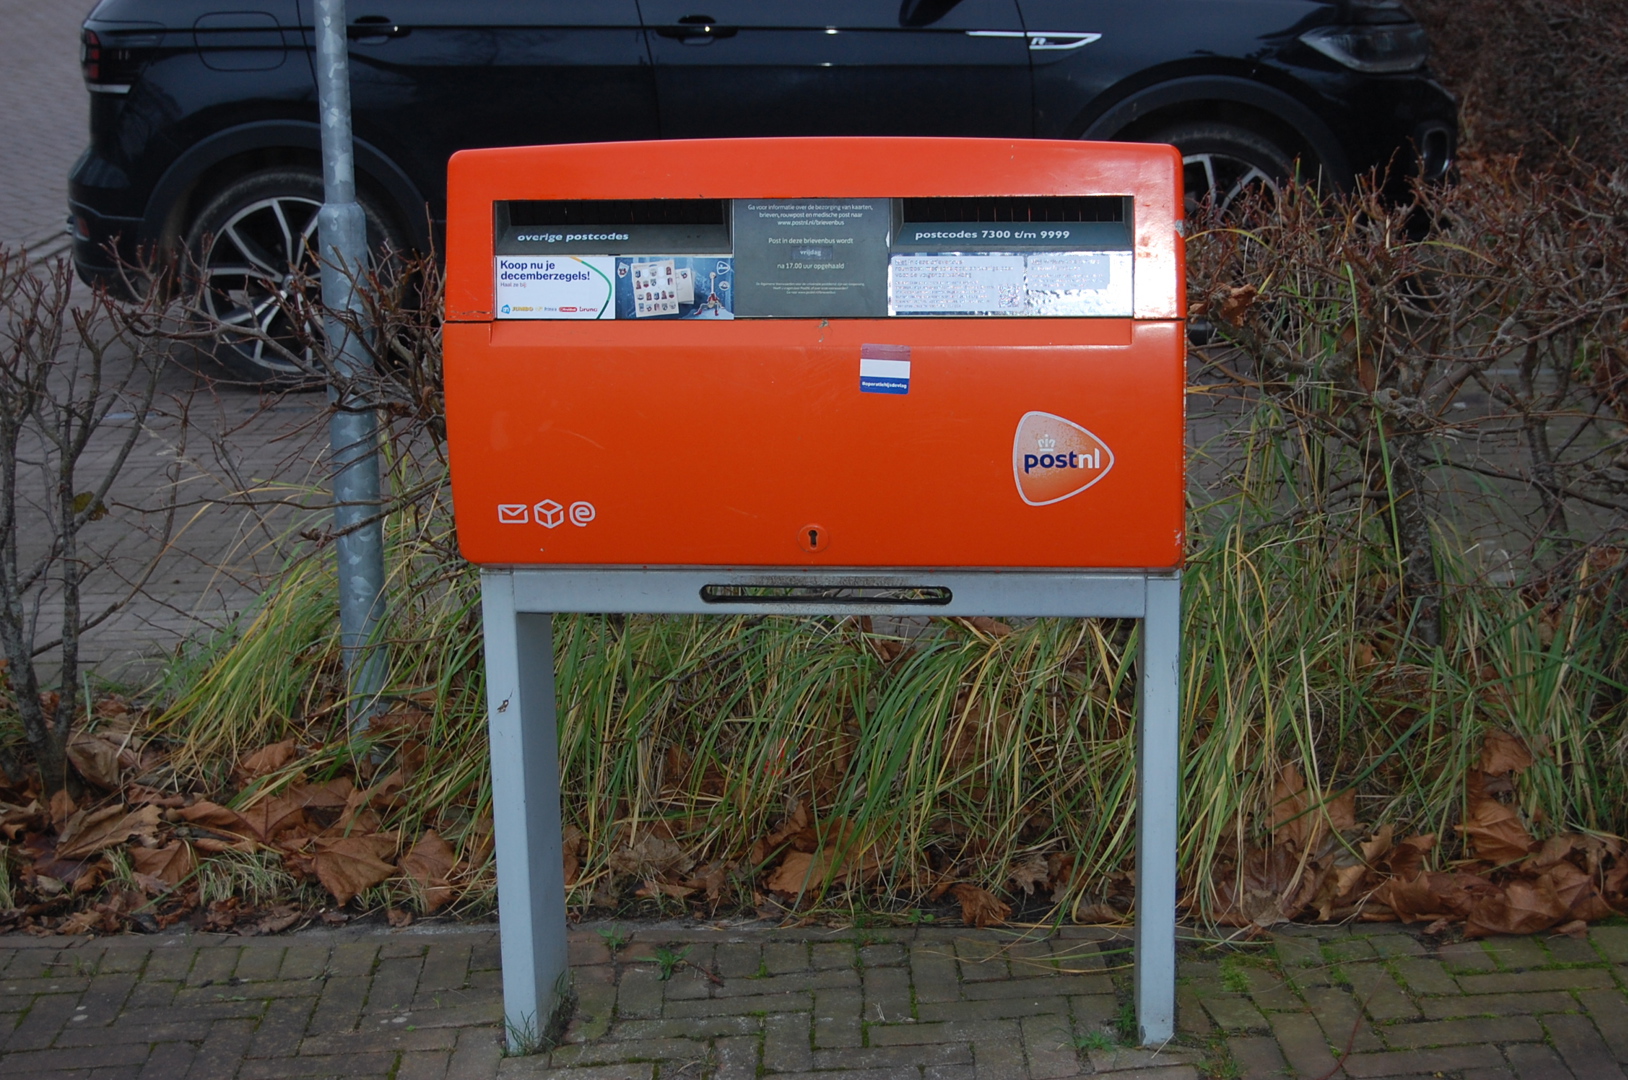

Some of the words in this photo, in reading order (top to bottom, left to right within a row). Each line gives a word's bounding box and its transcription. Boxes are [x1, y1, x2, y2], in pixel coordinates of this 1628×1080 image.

[815, 203, 841, 212] bezorging
[852, 203, 873, 211] kaarten,
[517, 233, 563, 242] overige
[565, 232, 629, 242] postcodes
[915, 230, 978, 240] postcodes
[981, 230, 1011, 239] 7300
[1014, 230, 1037, 240] t/m
[1039, 230, 1070, 239] 9999
[800, 249, 822, 257] vrijdag
[500, 260, 528, 271] Koop
[530, 262, 544, 270] nu
[545, 261, 556, 271] je
[814, 262, 845, 270] opgehaald
[500, 271, 591, 282] decemberzegels!
[1024, 448, 1100, 474] postnl
